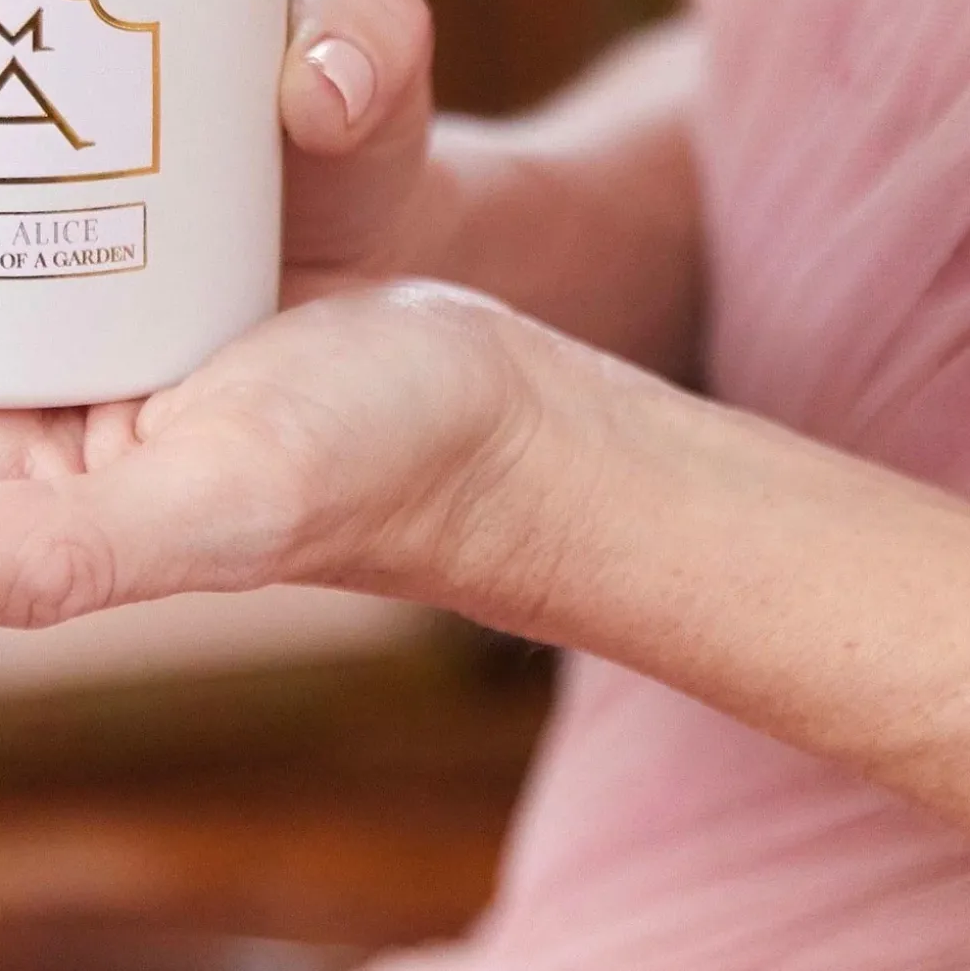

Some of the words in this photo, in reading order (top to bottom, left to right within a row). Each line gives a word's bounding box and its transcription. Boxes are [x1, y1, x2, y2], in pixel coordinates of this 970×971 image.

[12, 217, 99, 246] ALICE
[0, 251, 28, 270] OF
[34, 251, 47, 269] A
[53, 244, 135, 267] GARDEN
